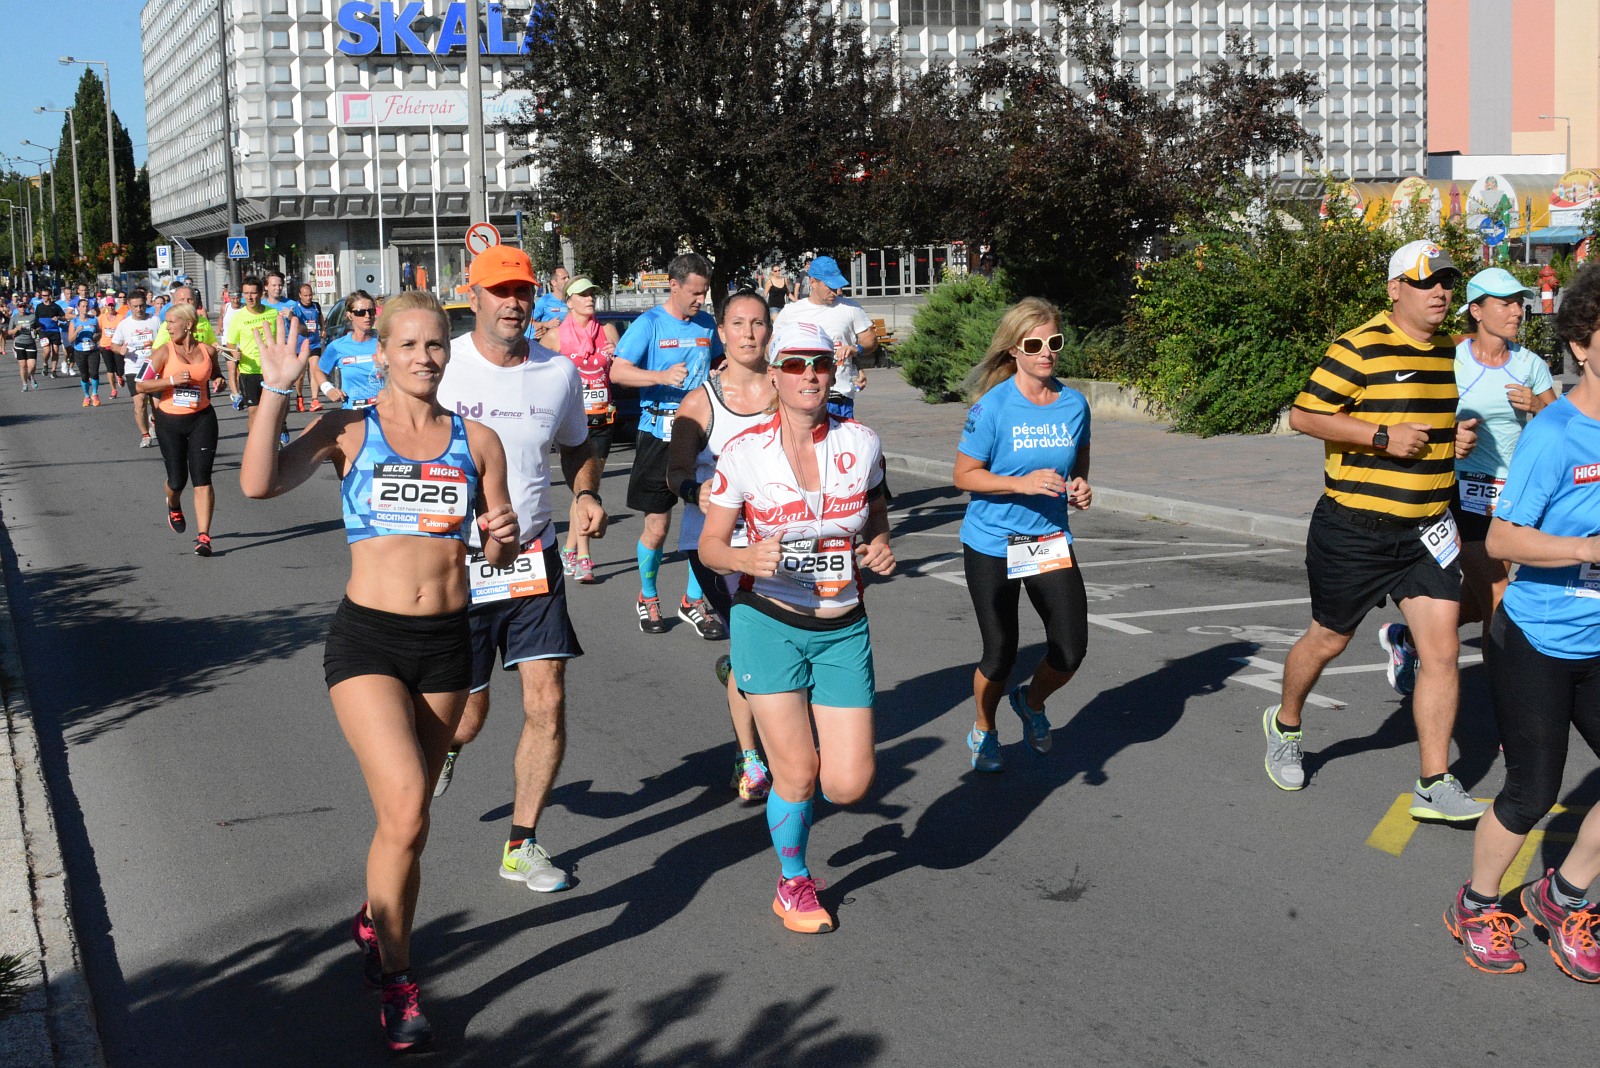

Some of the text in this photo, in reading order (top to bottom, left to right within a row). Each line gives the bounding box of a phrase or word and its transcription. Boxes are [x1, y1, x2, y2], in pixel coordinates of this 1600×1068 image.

[379, 95, 456, 123] Fehérvár
[316, 269, 334, 277] VÁSÁR
[456, 401, 483, 418] bd
[1012, 422, 1050, 438] péceli
[393, 464, 460, 477] cep HIGH5
[380, 482, 459, 505] 2026
[1466, 483, 1502, 499] 213
[765, 495, 865, 523] Pearl Izumi
[376, 512, 417, 523] DECATHLON
[796, 539, 845, 549] cep HIGH5
[784, 554, 845, 573] 0258
[476, 584, 508, 595] DECATHLON
